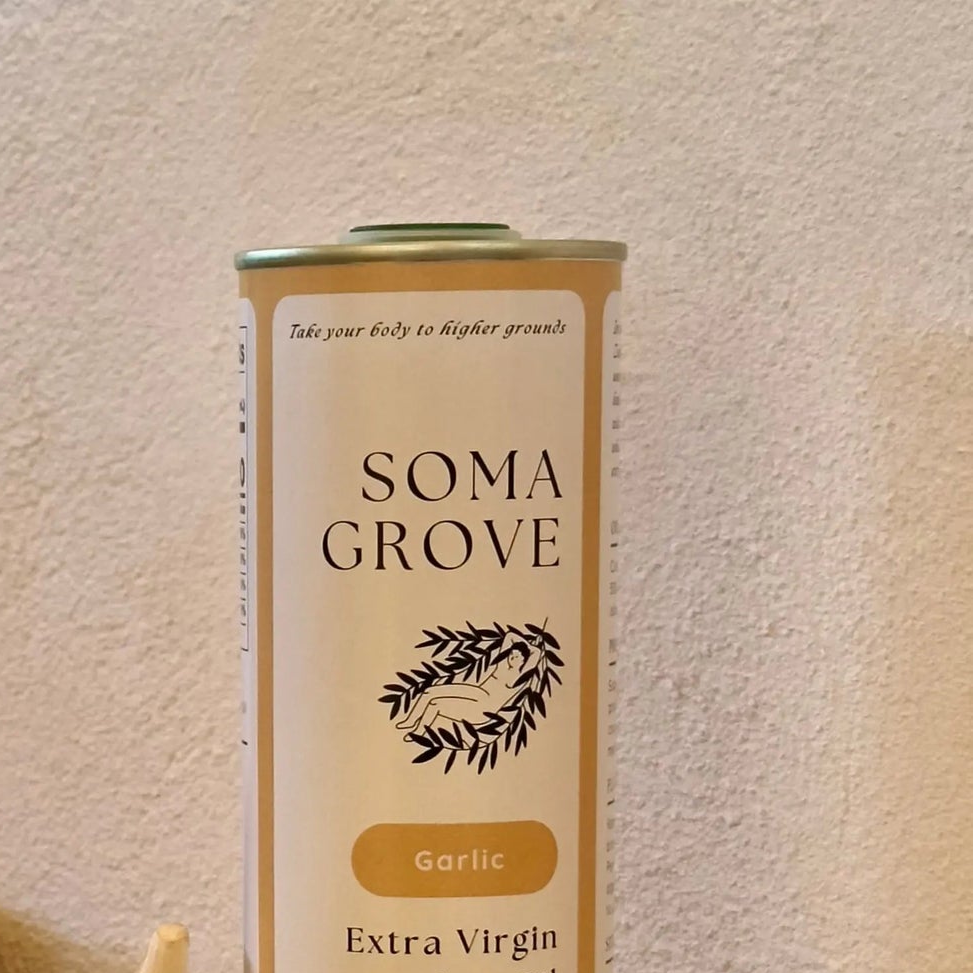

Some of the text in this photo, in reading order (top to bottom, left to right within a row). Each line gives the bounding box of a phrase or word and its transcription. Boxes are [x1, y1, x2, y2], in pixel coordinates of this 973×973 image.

[289, 318, 567, 342] Take your body to higher grounds
[361, 448, 564, 503] SOMA
[322, 517, 560, 571] GROVE
[414, 848, 504, 872] Garlic
[346, 925, 558, 962] Extra Virgin
